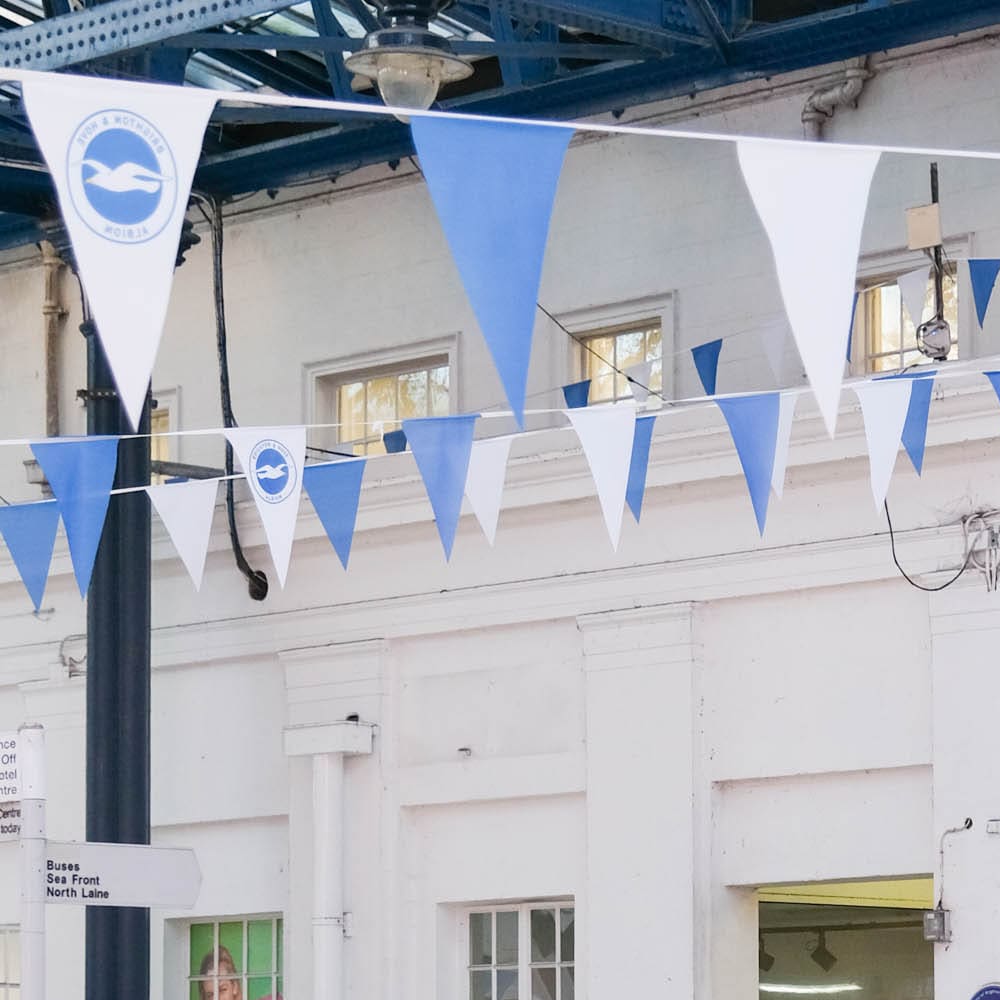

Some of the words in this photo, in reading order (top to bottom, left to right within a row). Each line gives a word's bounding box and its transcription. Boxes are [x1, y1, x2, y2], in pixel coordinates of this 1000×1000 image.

[46, 860, 80, 873] Buses
[46, 874, 67, 886] Sea
[72, 874, 101, 887] Front
[46, 887, 77, 899] North
[81, 888, 110, 900] Laine
